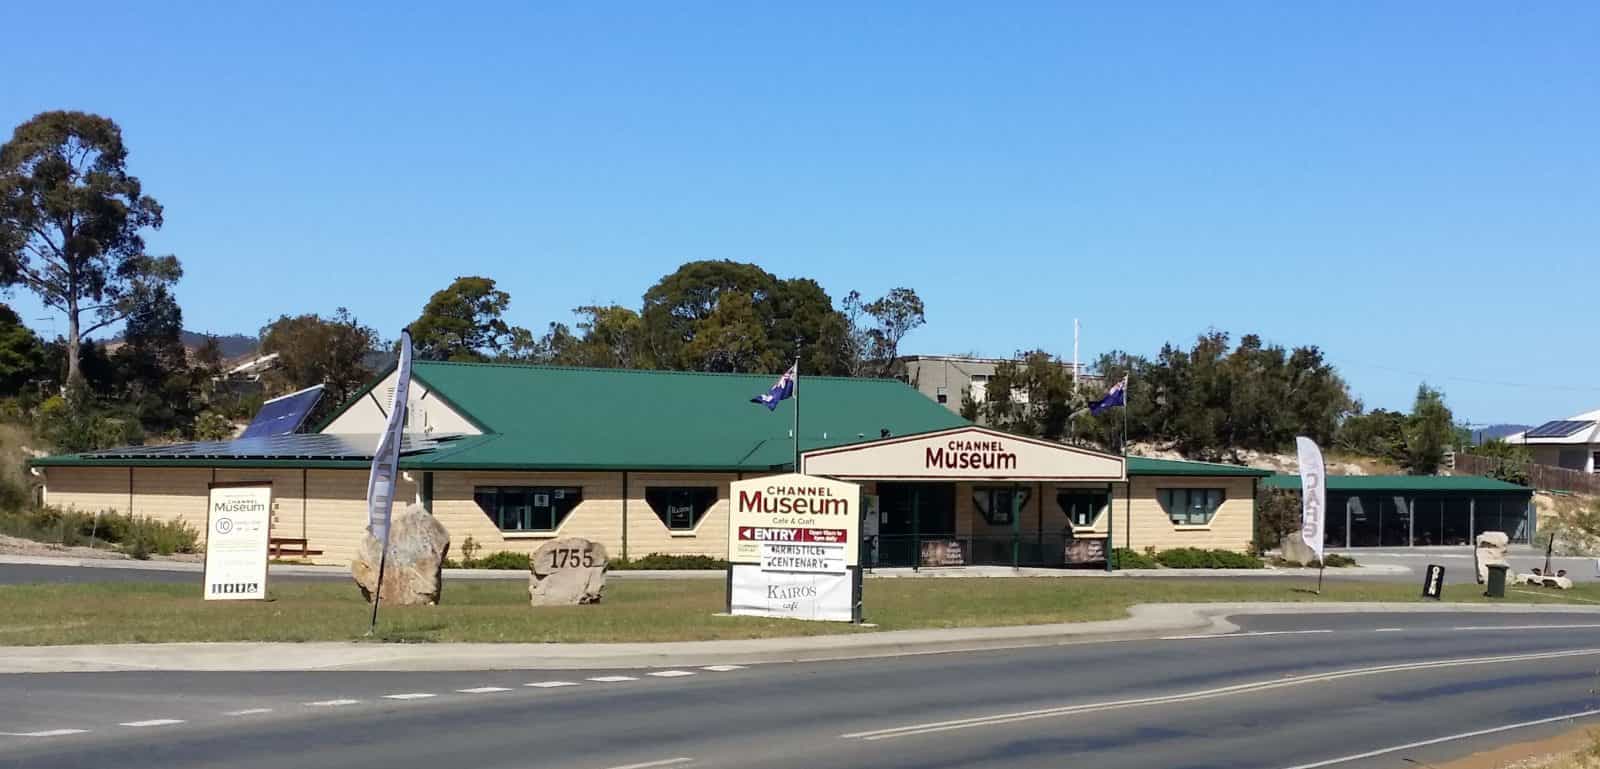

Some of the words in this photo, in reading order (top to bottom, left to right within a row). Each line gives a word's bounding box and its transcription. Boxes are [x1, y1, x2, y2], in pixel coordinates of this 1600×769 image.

[948, 440, 1005, 452] CHANNEL
[926, 447, 1016, 469] Museum
[767, 486, 833, 497] CHANNEL
[214, 502, 265, 512] Museum
[739, 490, 848, 515] Museum
[754, 529, 797, 541] ENTRY
[550, 548, 593, 569] 1755
[771, 556, 824, 569] CENTENARY
[767, 584, 817, 599] KAIROS
